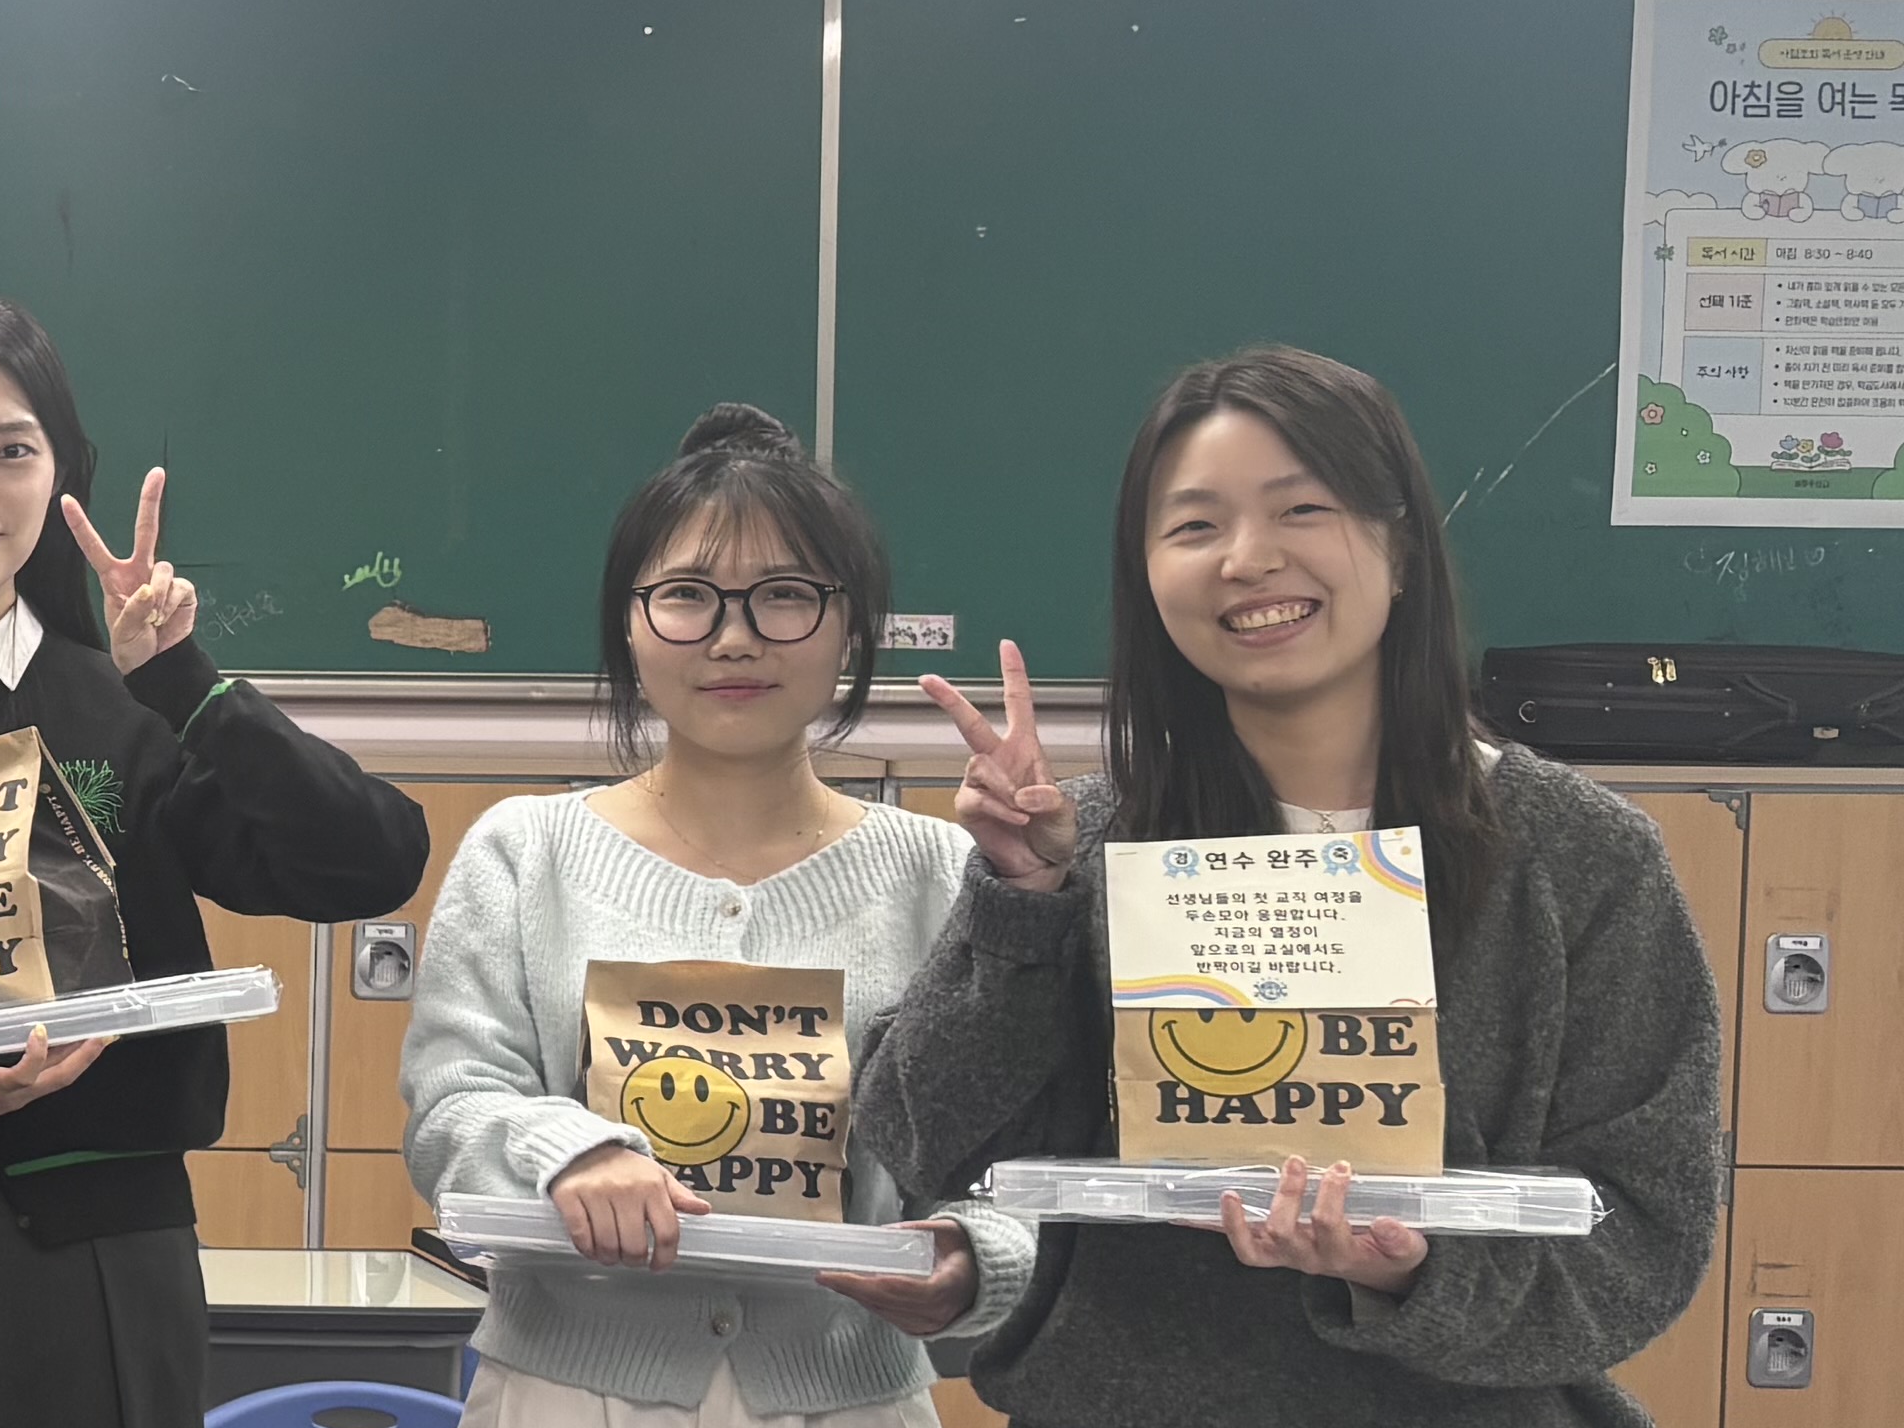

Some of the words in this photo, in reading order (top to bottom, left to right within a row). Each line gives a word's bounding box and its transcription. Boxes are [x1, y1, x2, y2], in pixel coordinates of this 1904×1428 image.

[1710, 80, 1804, 118] 아침을
[1818, 82, 1878, 119] 여는
[1702, 247, 1727, 260] 독서
[1731, 248, 1755, 261] 시간
[1776, 248, 1797, 260] 아침
[1804, 248, 1830, 259] 8:30
[1846, 249, 1873, 260] 8:40
[1699, 295, 1724, 308] 선택
[1729, 295, 1752, 309] 기준
[1173, 852, 1189, 866] 경
[1206, 851, 1255, 871] 연수
[1267, 849, 1319, 870] 완주
[1166, 893, 1246, 905] 선생님들의
[1254, 893, 1268, 904] 첫
[1276, 892, 1306, 903] 교직
[1314, 891, 1362, 903] 여정을
[1186, 910, 1249, 922] 두손모아
[1257, 909, 1345, 922] 응원합니다.
[1214, 927, 1262, 938] 지금의
[1270, 926, 1317, 938] 열정이
[1190, 944, 1255, 956] 앞으로의
[1264, 943, 1345, 955] 교실에서도
[1197, 961, 1261, 973] 반짝이길
[1269, 961, 1341, 973] 바랍니다.
[637, 1000, 829, 1038] DON'T
[1317, 1014, 1419, 1057] BE
[1155, 1081, 1421, 1127] HAPPY
[759, 1097, 836, 1141] BE
[676, 1156, 826, 1199] APPY
